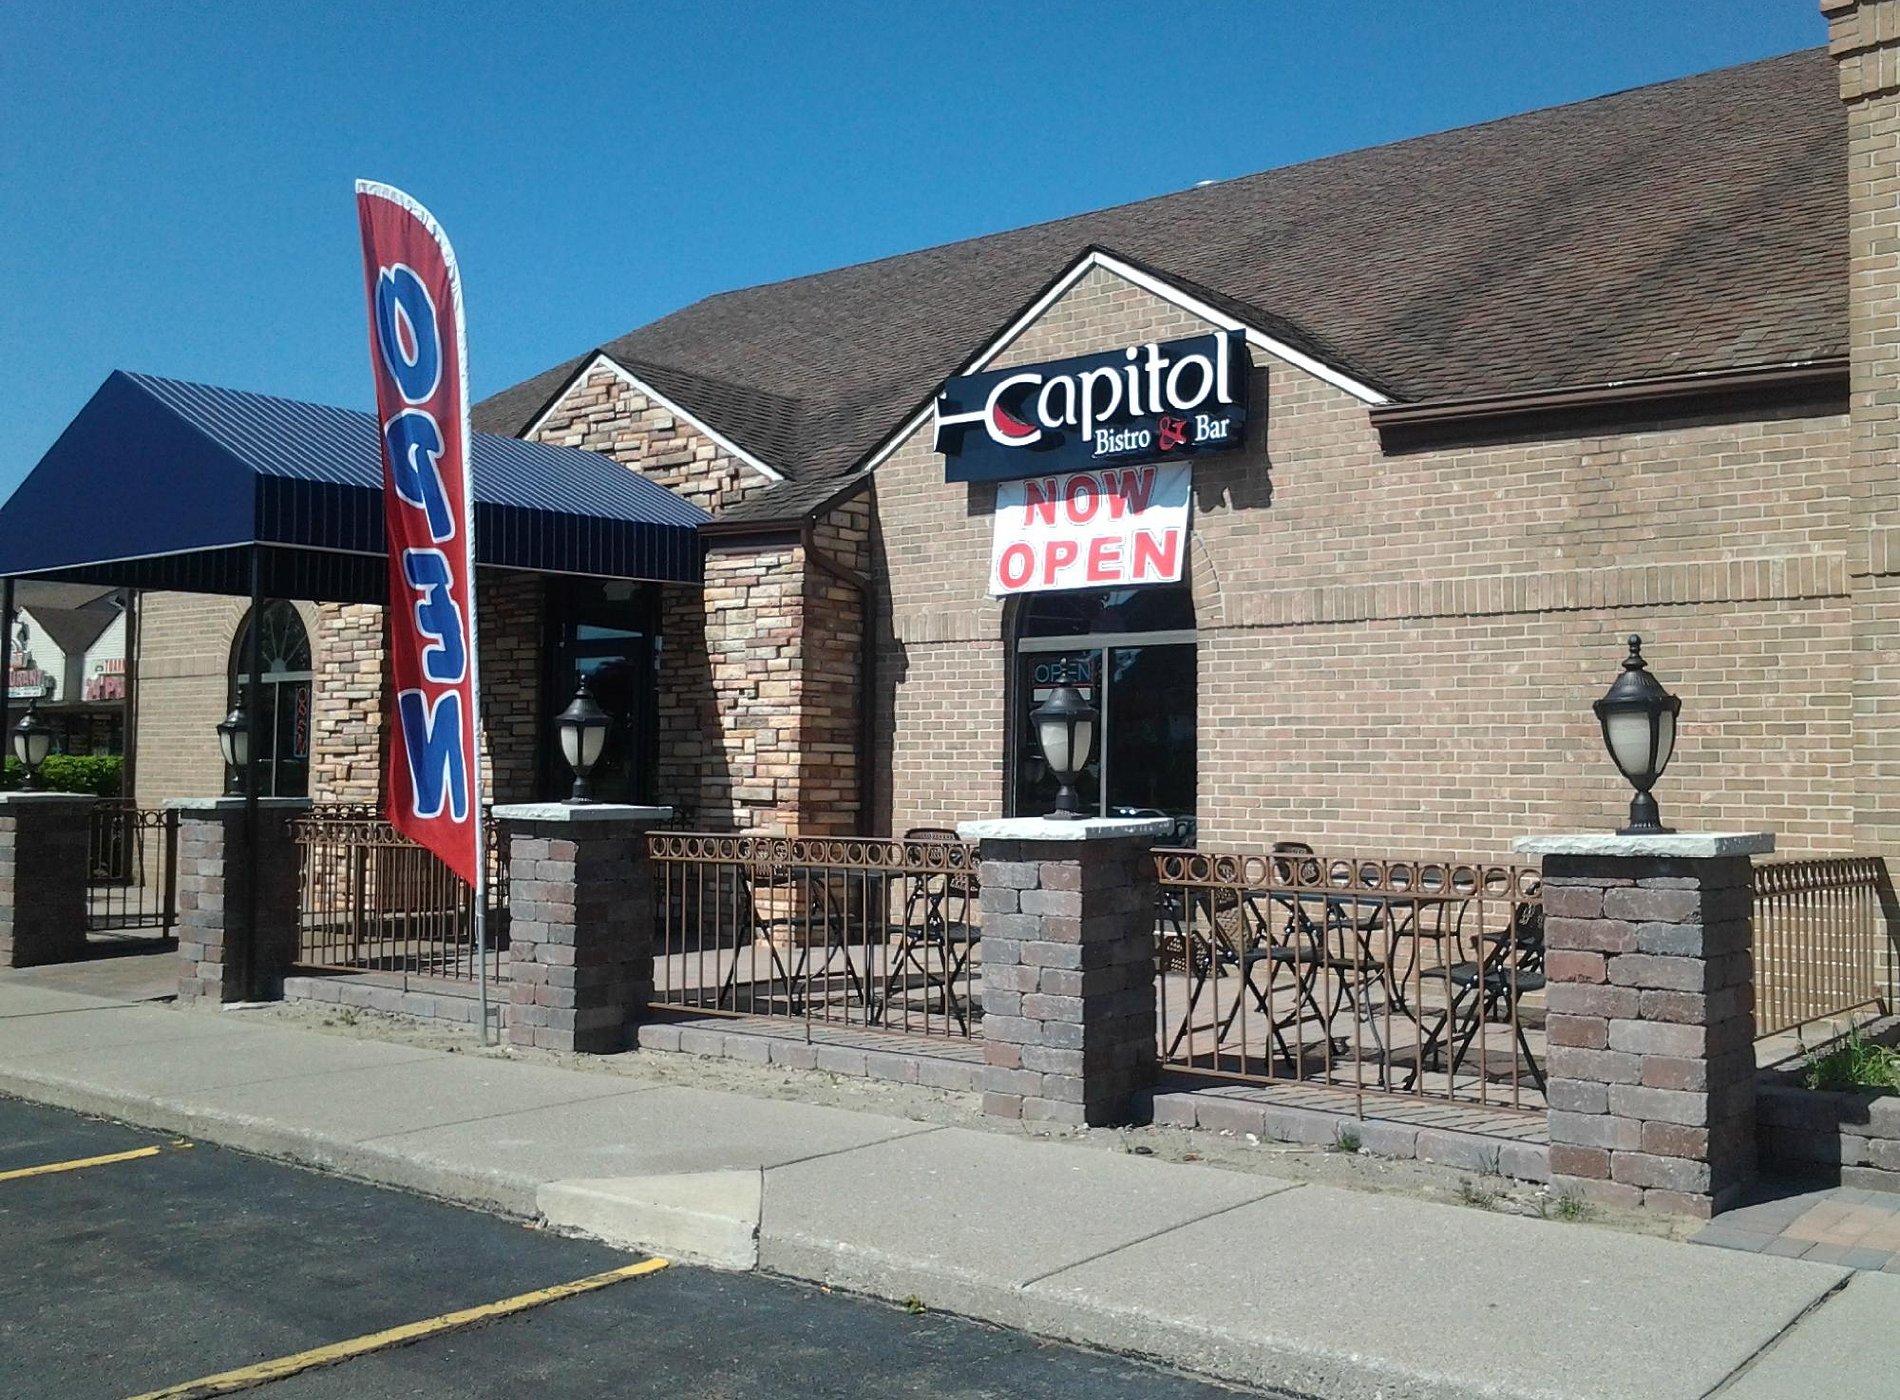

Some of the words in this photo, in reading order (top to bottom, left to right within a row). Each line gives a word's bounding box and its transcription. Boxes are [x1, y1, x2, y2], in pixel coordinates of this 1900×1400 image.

[984, 331, 1232, 447] Capitol
[1094, 428, 1151, 456] Bistro
[1158, 415, 1188, 451] &
[1194, 413, 1231, 442] Bar
[1023, 468, 1158, 526] NOW
[998, 530, 1179, 589] OPEN
